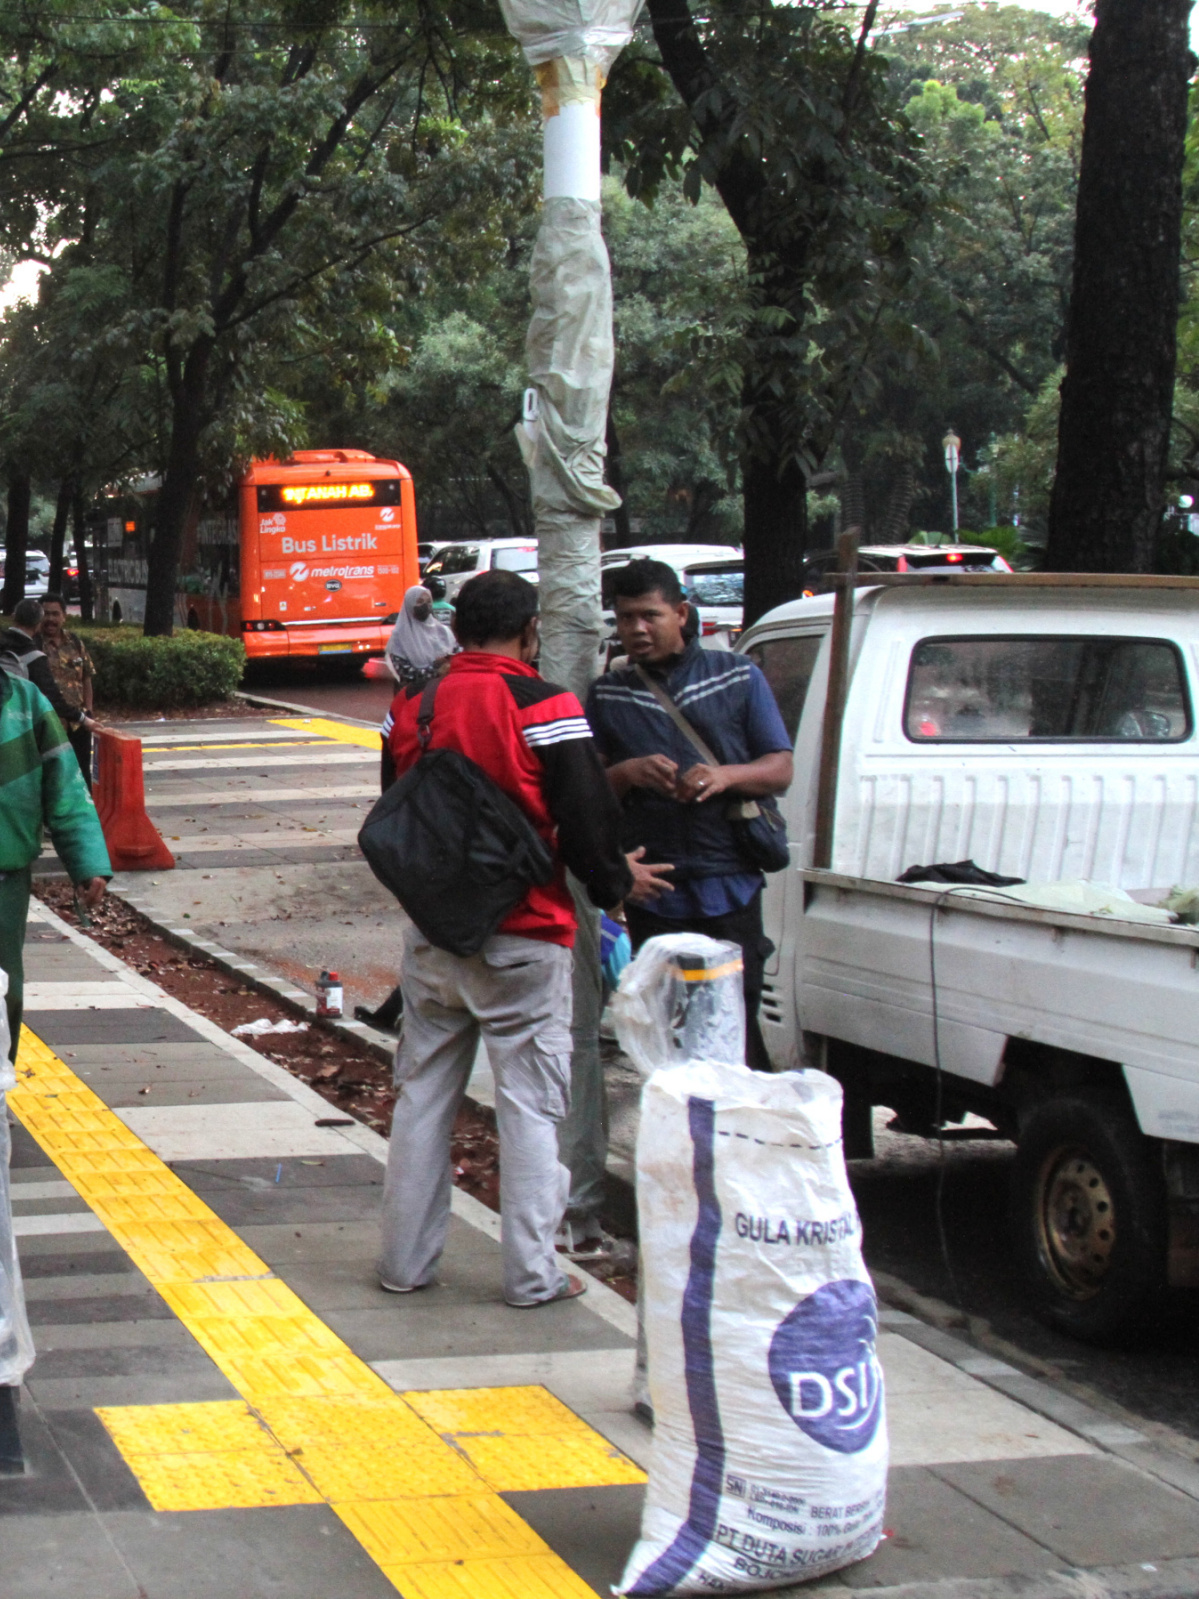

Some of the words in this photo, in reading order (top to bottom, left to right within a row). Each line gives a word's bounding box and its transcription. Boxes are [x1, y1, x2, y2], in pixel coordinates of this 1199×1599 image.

[260, 525, 286, 535] Lingko
[281, 537, 316, 553] Bus
[321, 533, 377, 551] Listrik
[310, 565, 375, 579] metrotrans
[735, 1212, 790, 1245] GULA
[789, 1362, 868, 1417] DSI
[810, 1505, 843, 1518] BERAT
[717, 1524, 740, 1549] PT
[743, 1535, 787, 1565] DUTA
